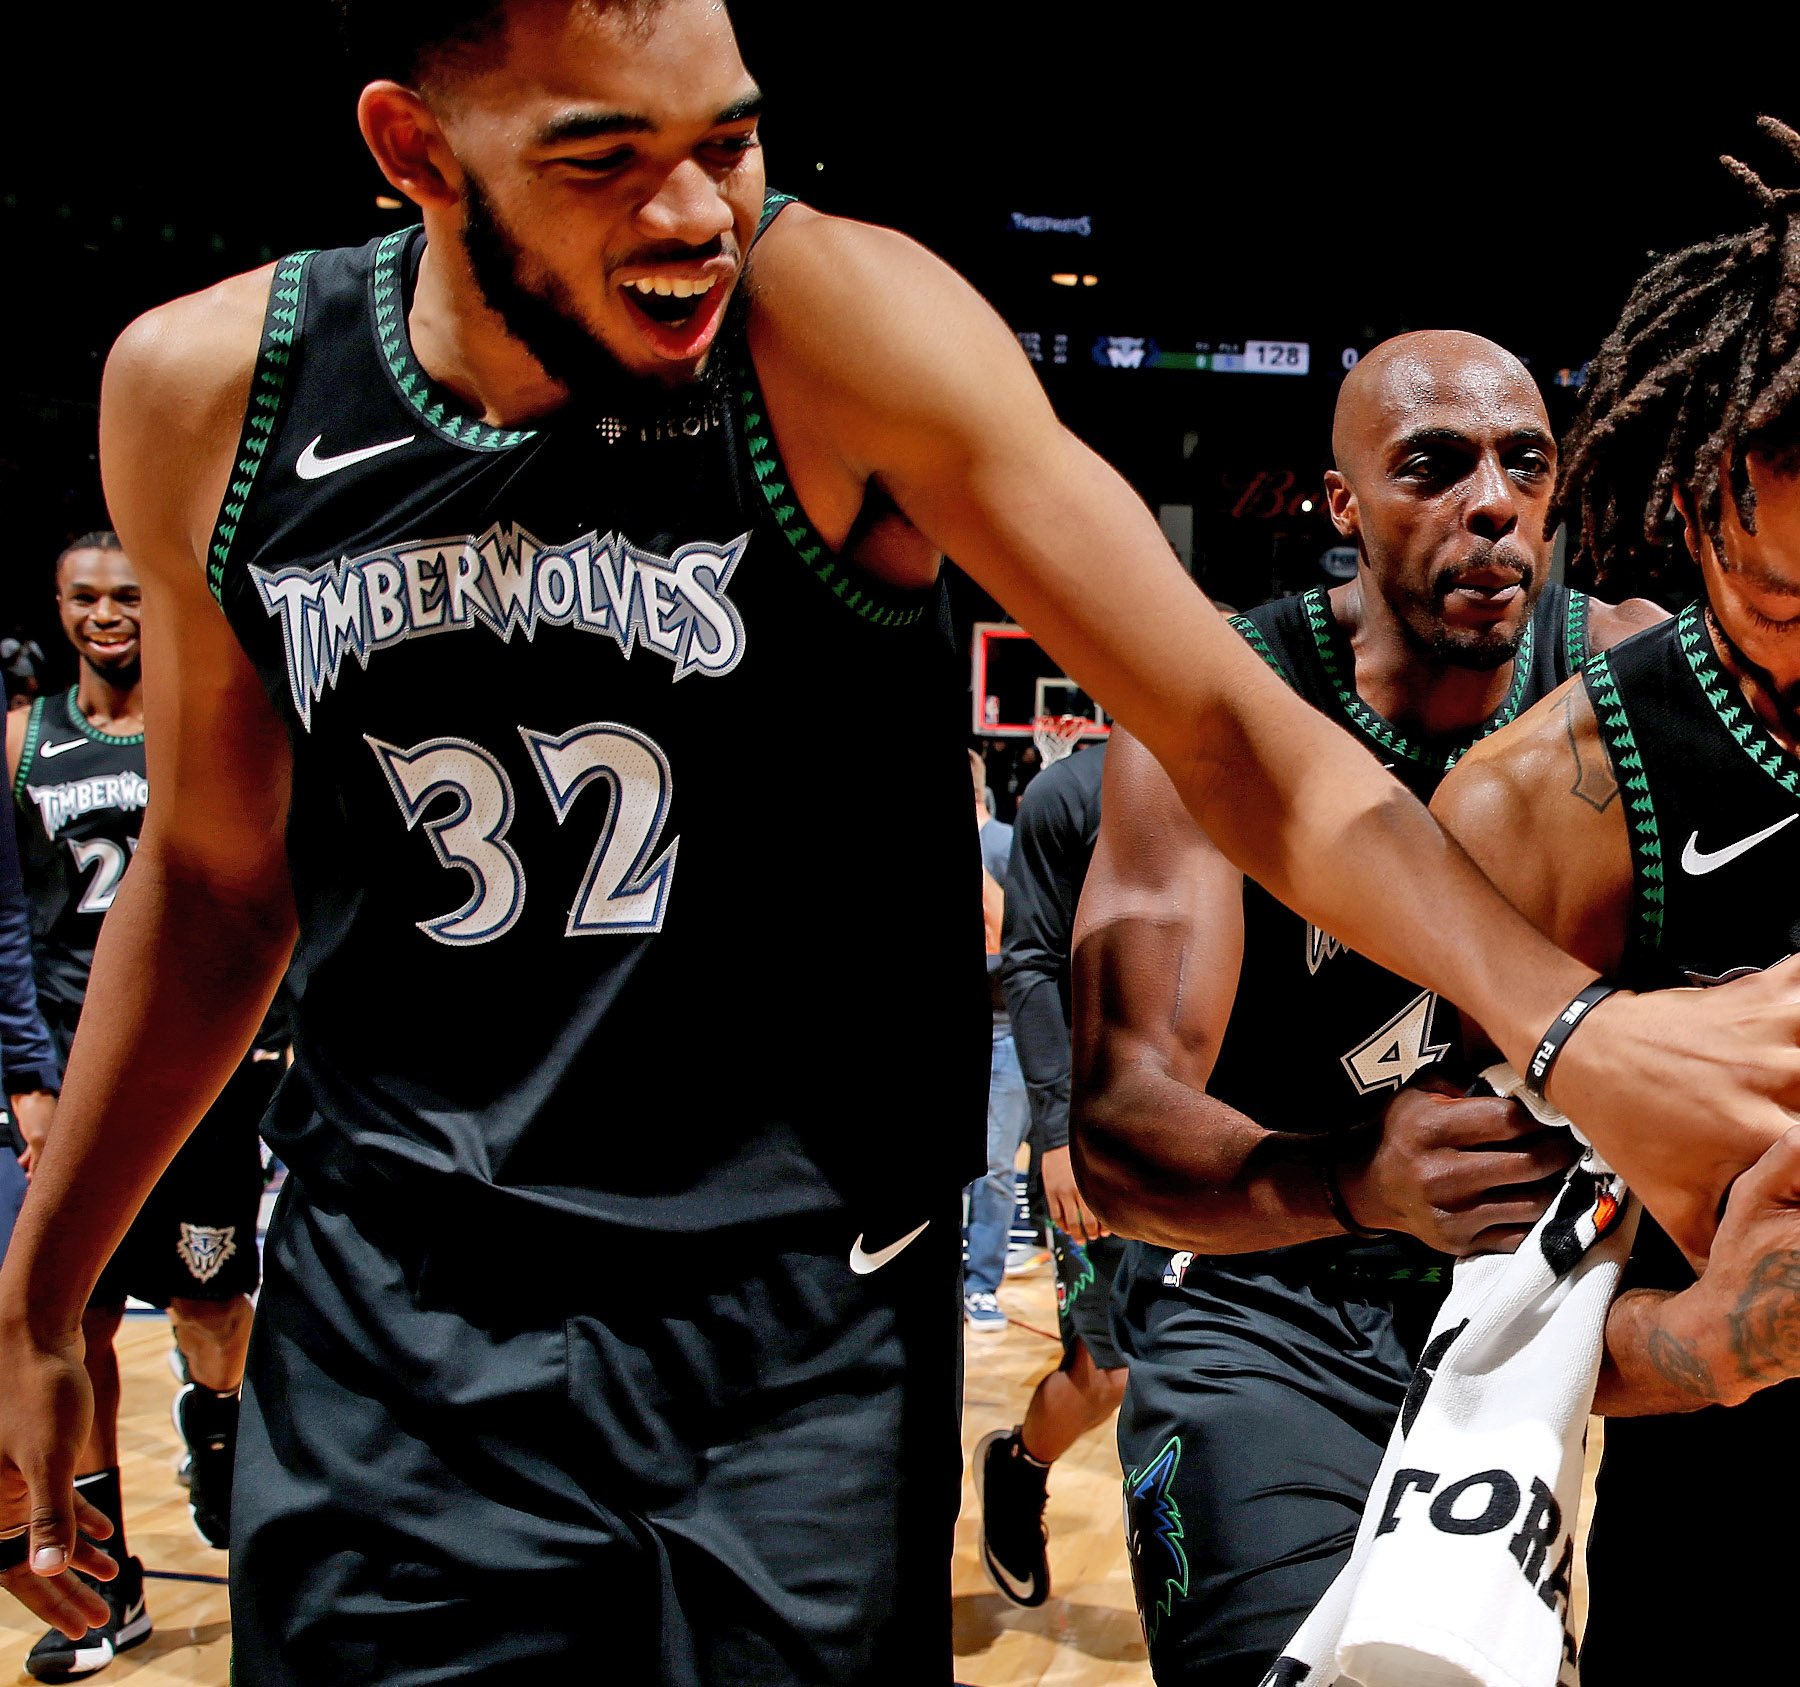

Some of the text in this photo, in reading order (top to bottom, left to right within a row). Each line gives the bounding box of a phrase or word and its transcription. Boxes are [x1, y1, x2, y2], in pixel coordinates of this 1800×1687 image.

[1256, 345, 1300, 367] 128
[248, 522, 752, 732] TIMBERWOLVES
[26, 770, 149, 841] TIMBERWO
[363, 721, 681, 946] 32
[67, 835, 139, 914] 2
[1340, 989, 1451, 1095] 4
[1532, 1000, 1588, 1077] WE FLIP
